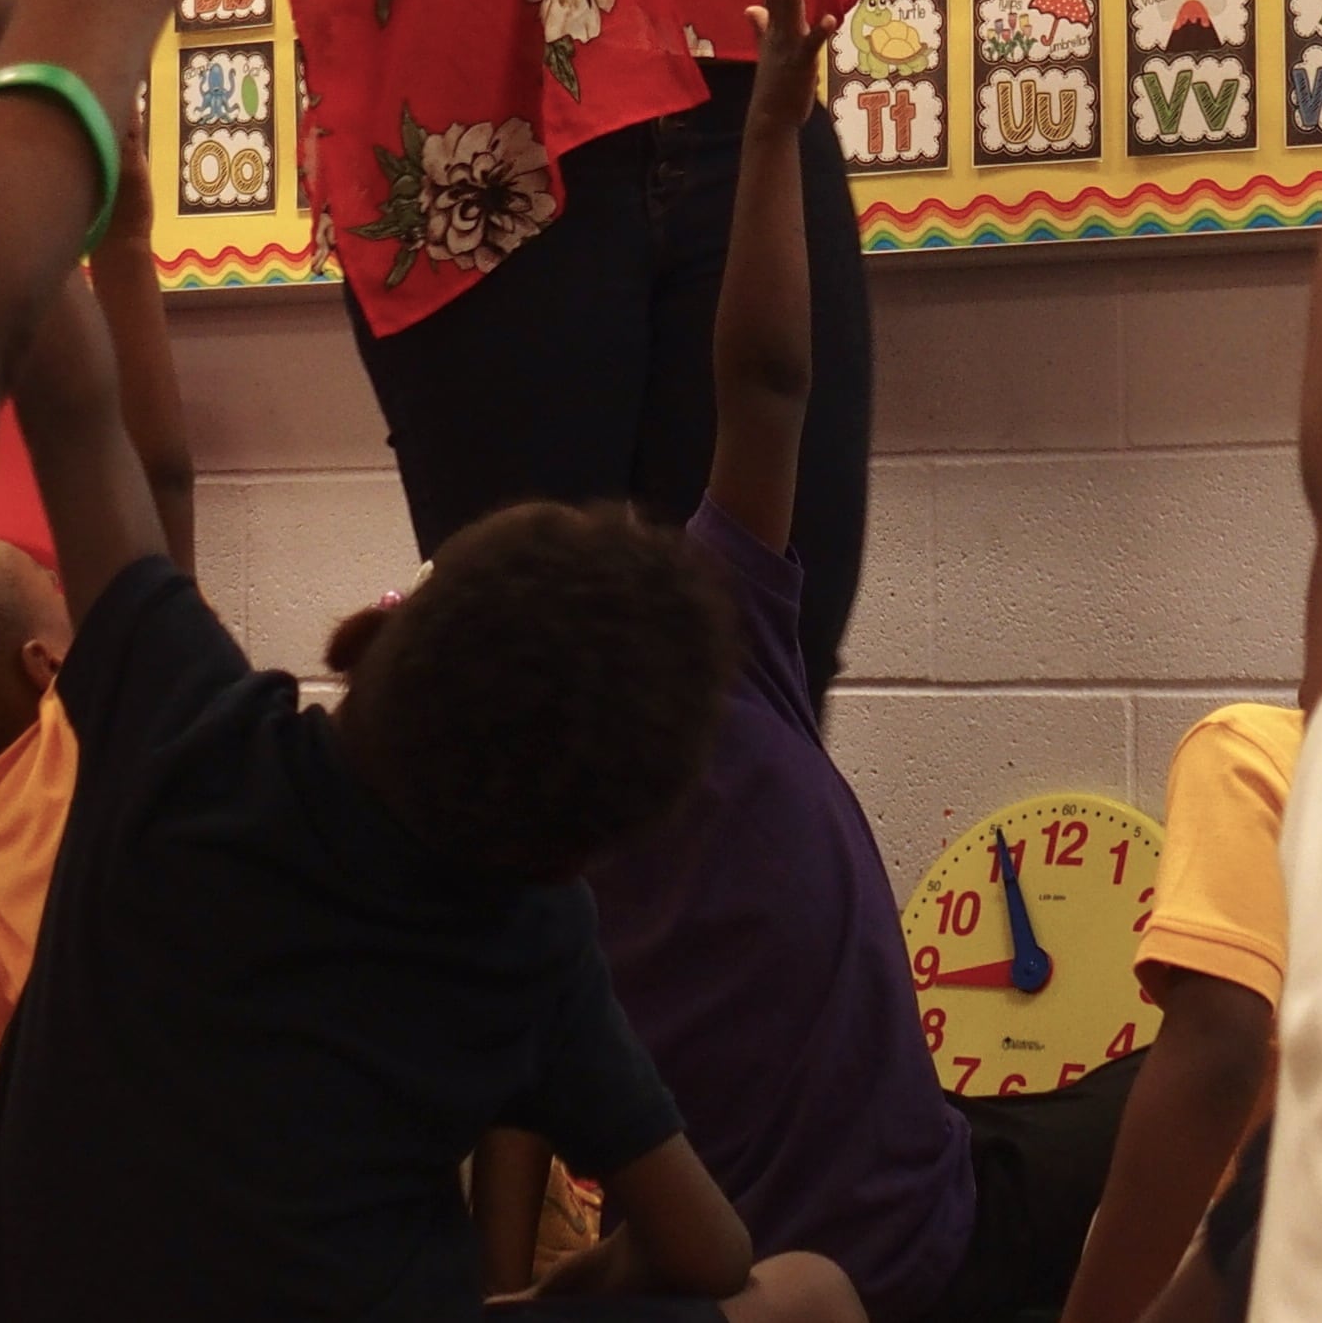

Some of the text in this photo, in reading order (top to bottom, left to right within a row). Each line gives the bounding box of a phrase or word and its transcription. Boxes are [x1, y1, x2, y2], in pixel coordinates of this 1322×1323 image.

[898, 5, 926, 21] turtle
[1049, 35, 1088, 56] umbrella
[858, 90, 917, 154] Tt
[997, 80, 1077, 143] Uu
[1143, 70, 1239, 135] Vv
[189, 140, 264, 197] Oo
[1062, 804, 1077, 815] 60
[1133, 826, 1141, 838] 5
[987, 839, 1026, 884] 11
[1042, 821, 1088, 866] 12
[1110, 840, 1130, 884] 1
[927, 880, 941, 892] 50
[936, 890, 981, 936] 10
[913, 946, 940, 991] 9
[921, 1008, 947, 1054] 8
[1106, 1022, 1136, 1059] 4
[952, 1056, 981, 1095] 7
